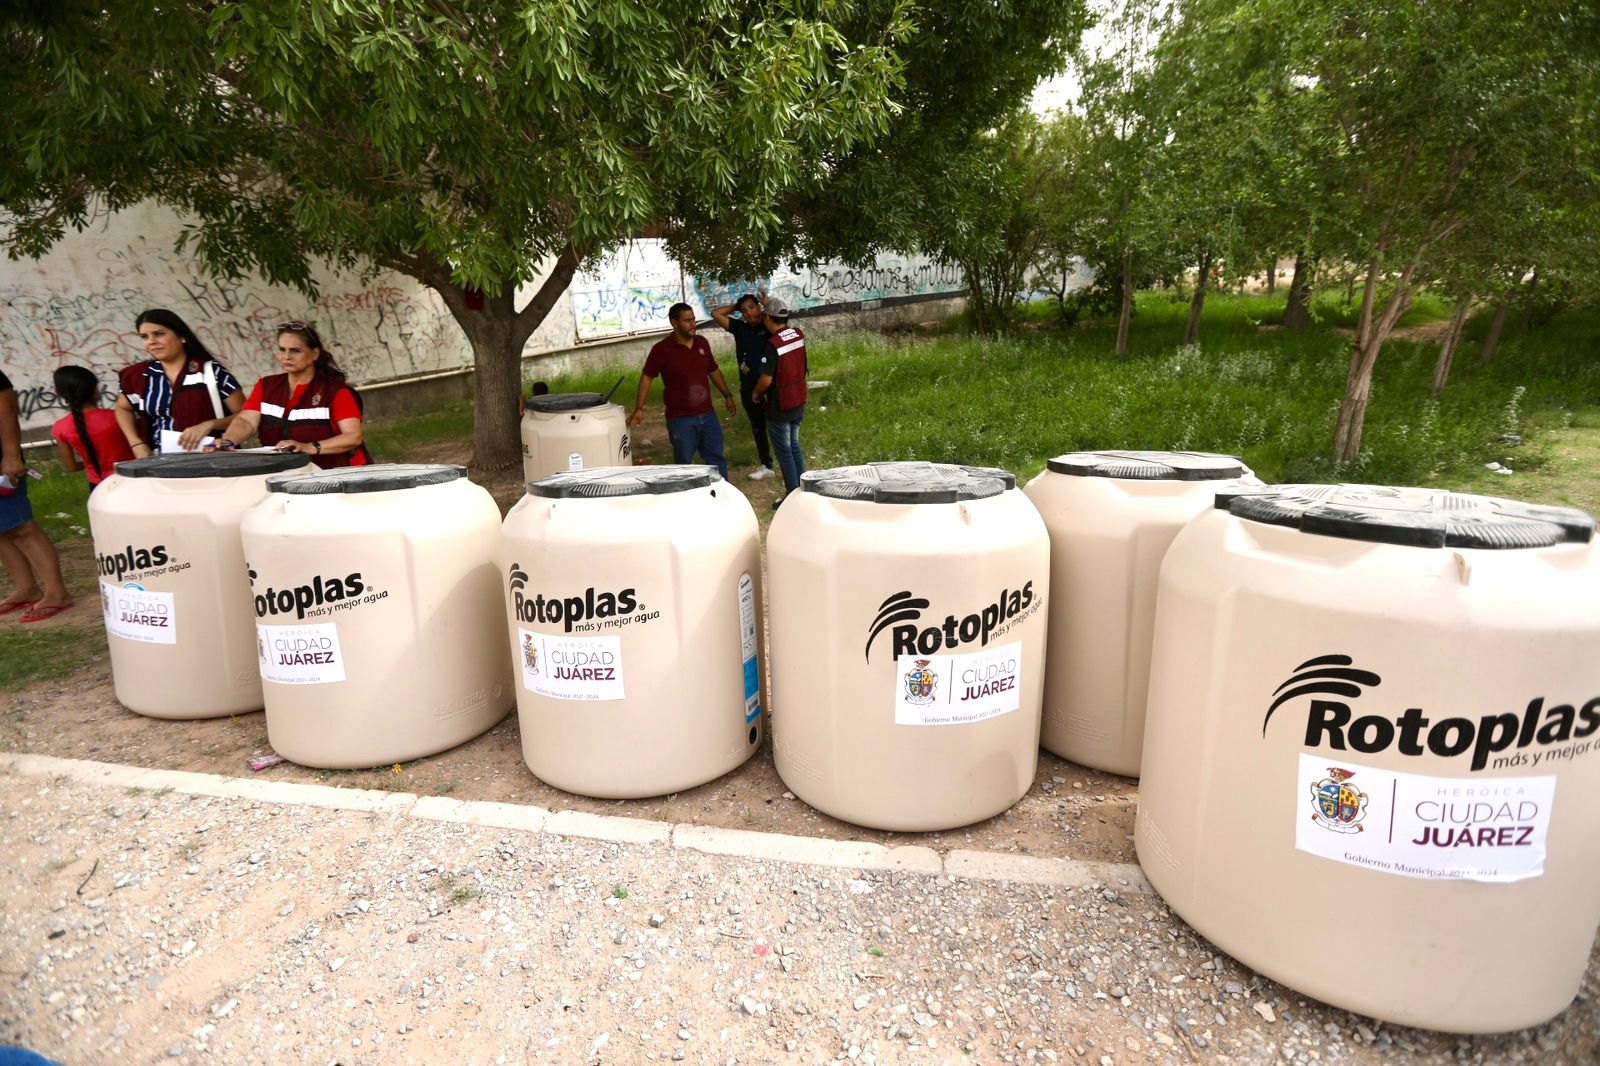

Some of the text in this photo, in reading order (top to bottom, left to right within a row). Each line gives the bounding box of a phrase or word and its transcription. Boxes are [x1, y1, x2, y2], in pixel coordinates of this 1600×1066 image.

[144, 567, 166, 578] mejor
[168, 562, 191, 573] agua
[119, 599, 169, 615] CIUDAD
[255, 572, 364, 620] otoplas
[307, 590, 389, 618] más y mejor agua
[120, 611, 169, 627] JUÁREZ
[514, 587, 637, 633] Rotoplas
[575, 610, 660, 632] más y mejor agua
[893, 580, 1033, 661] Rotoplas
[990, 627, 1005, 641] más
[1005, 623, 1011, 634] y
[1011, 610, 1030, 628] mejor
[274, 637, 332, 652] CIUDAD
[278, 650, 335, 666] JUÁREZ
[551, 650, 615, 666] CIUDAD
[962, 658, 1017, 684] CIUDAD
[553, 665, 616, 681] JUÁREZ
[961, 675, 1016, 702] JUÁREZ
[1304, 696, 1600, 772] Rotoplas
[1493, 752, 1528, 770] más
[1531, 752, 1542, 767] y
[1545, 740, 1592, 762] mejor
[1414, 801, 1539, 824] CIUDAD
[1411, 822, 1536, 848] JUÁREZ
[1344, 851, 1391, 870] Gobierno
[1393, 862, 1446, 878] Municipal
